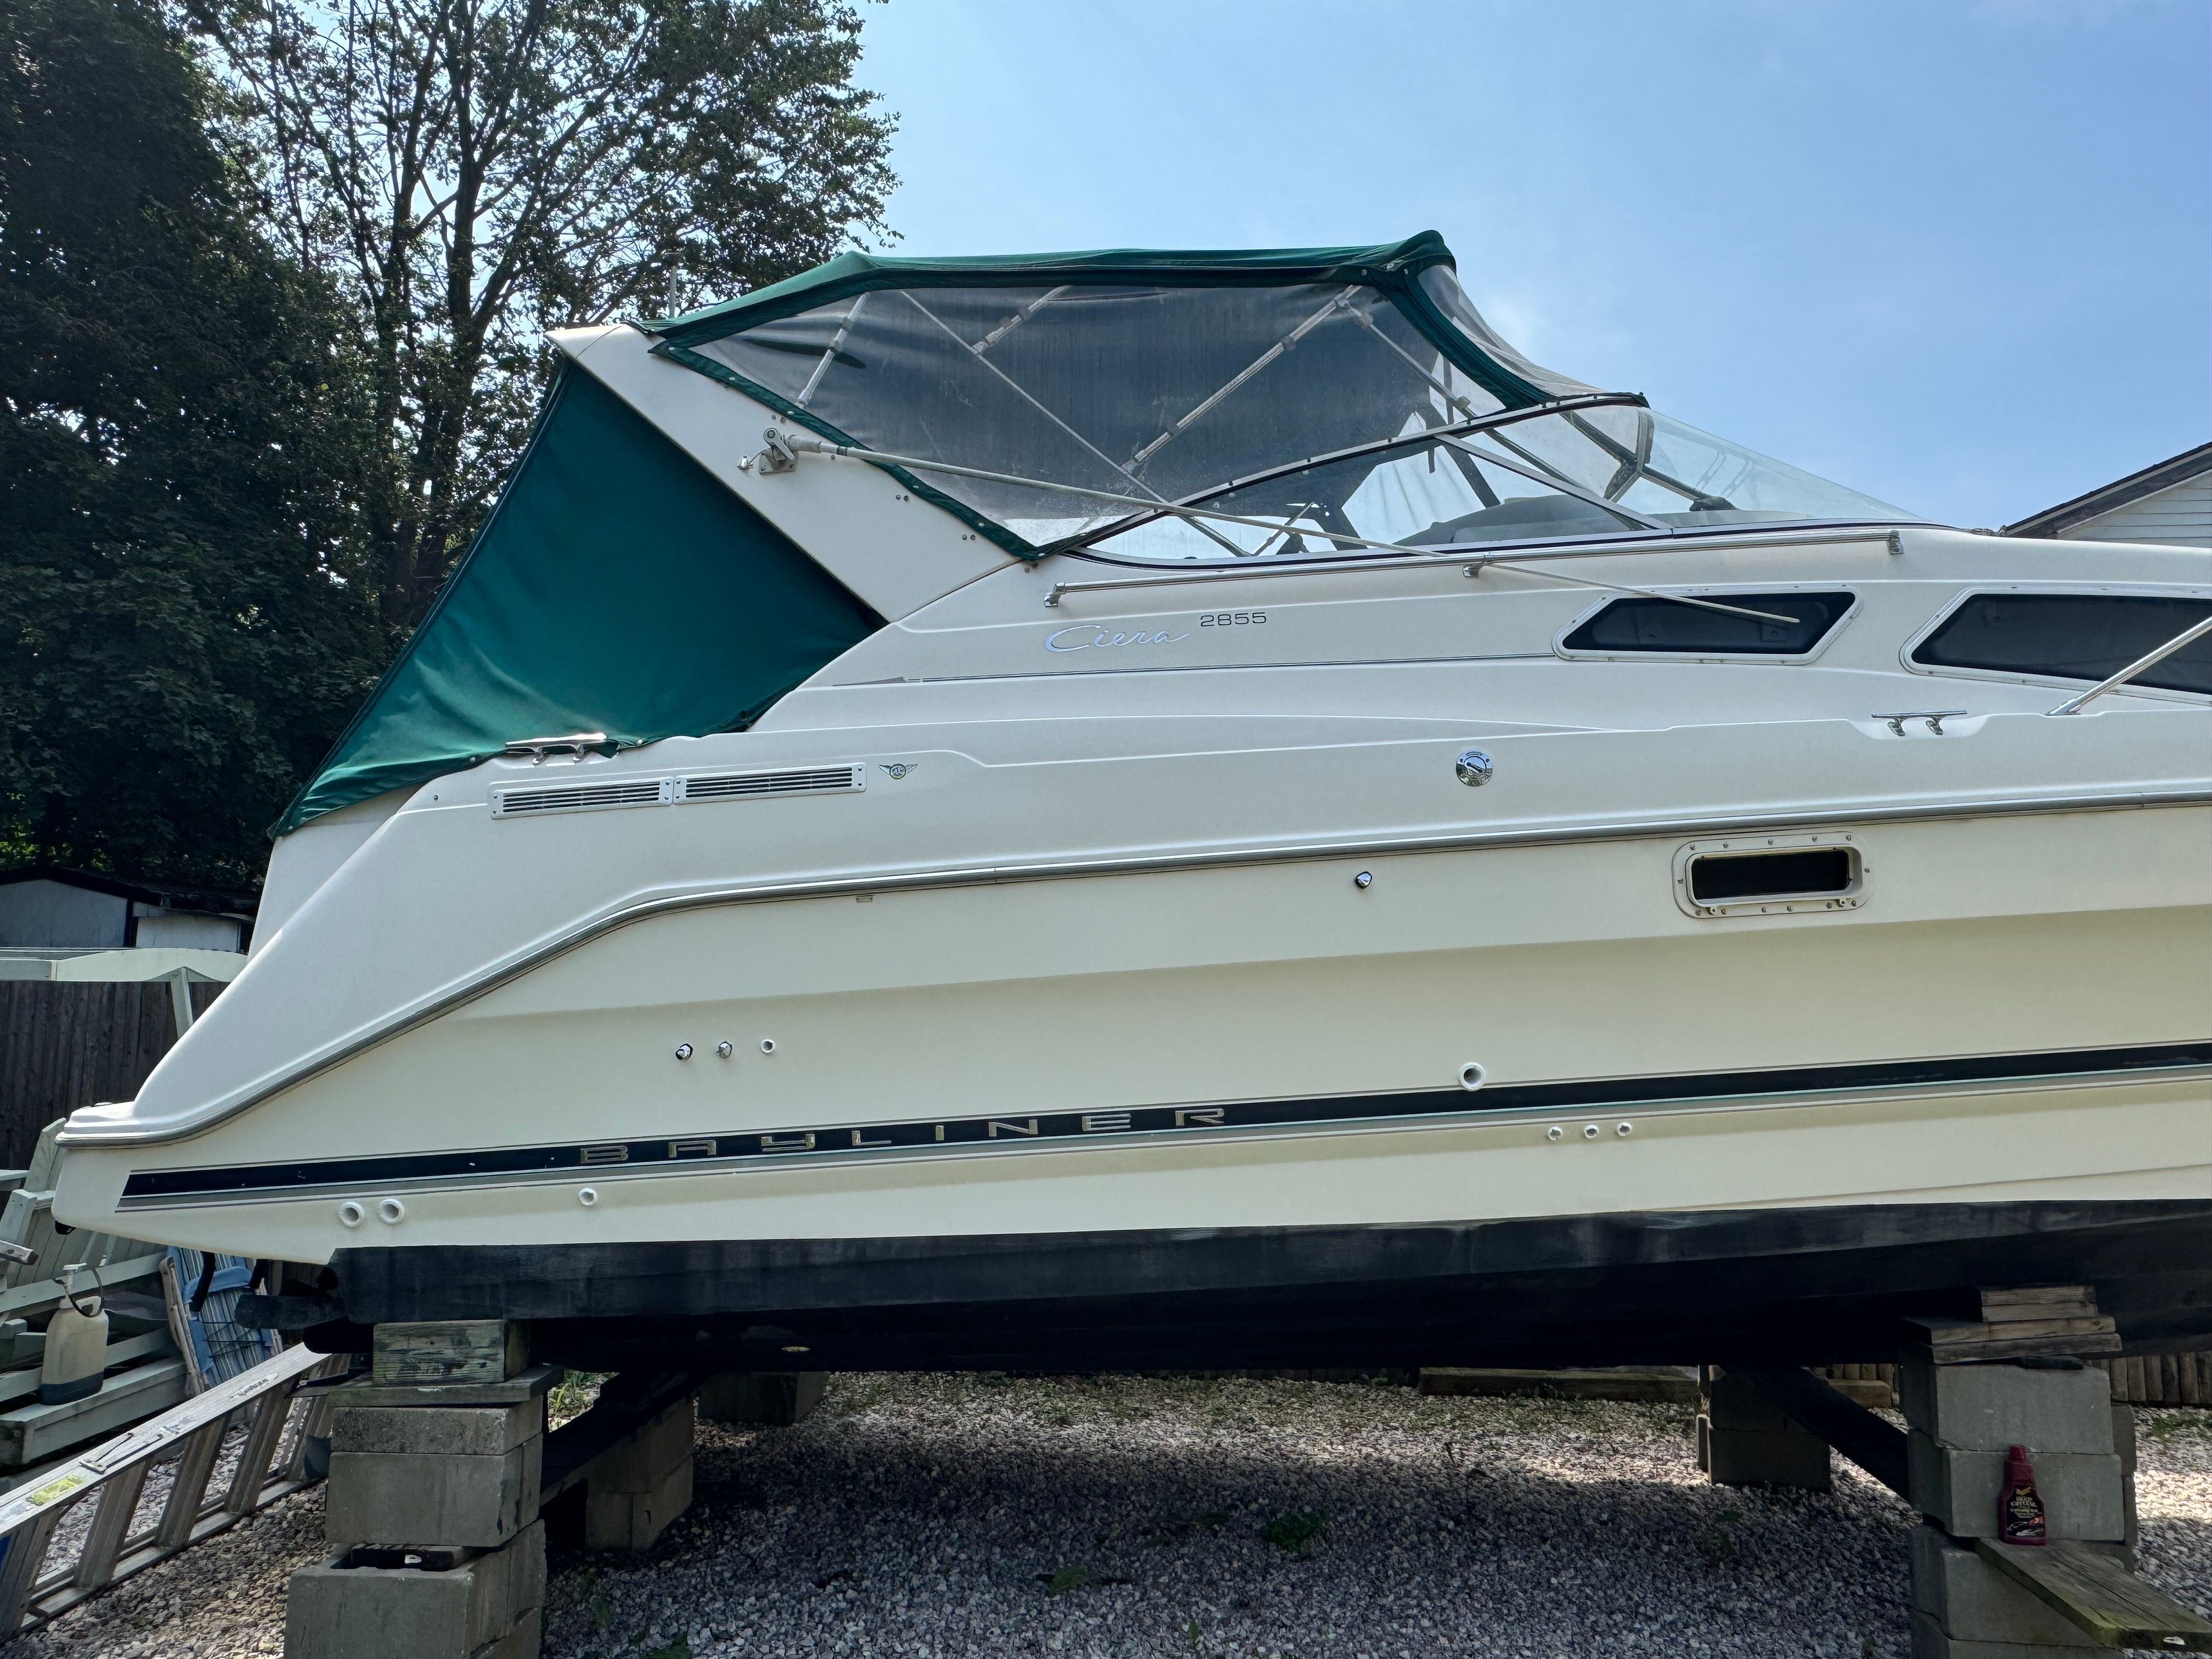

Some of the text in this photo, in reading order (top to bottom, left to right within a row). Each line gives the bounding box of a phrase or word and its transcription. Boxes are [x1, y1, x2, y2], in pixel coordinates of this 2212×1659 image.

[1044, 612, 1267, 652] Ciera 2855
[580, 1108, 1225, 1164] BAYLINER
